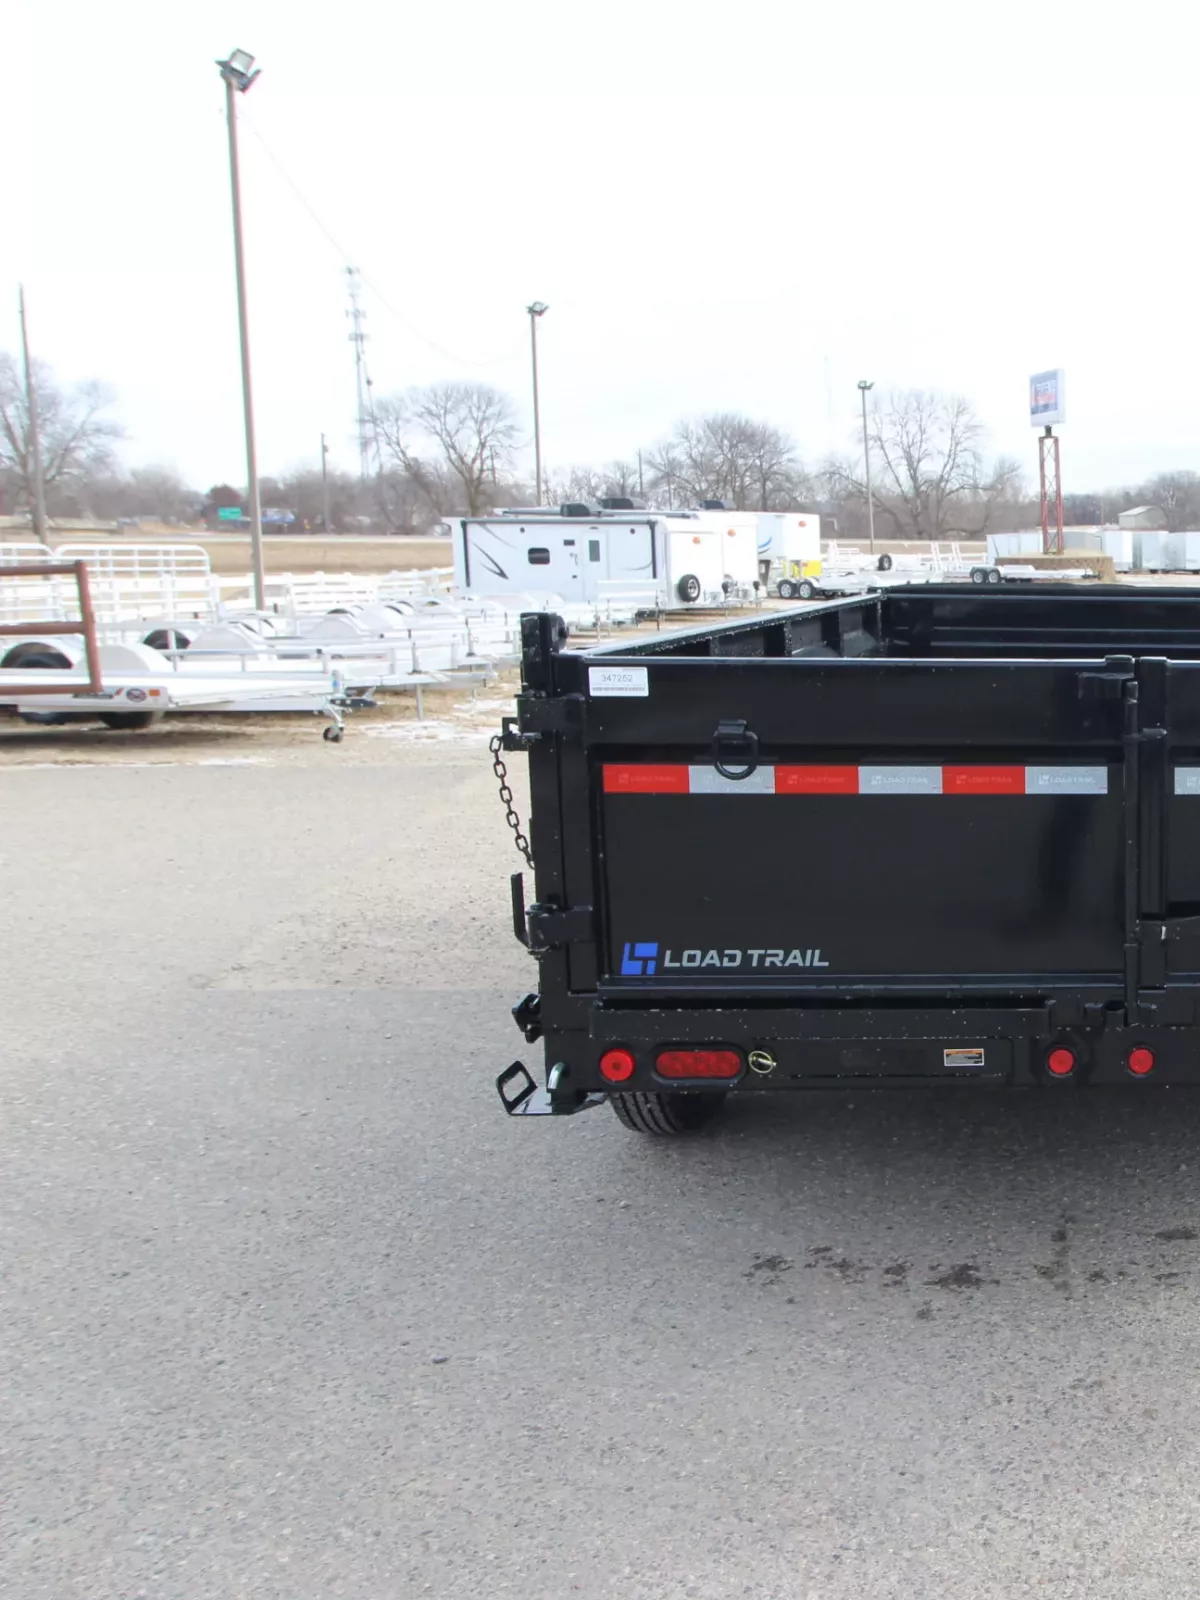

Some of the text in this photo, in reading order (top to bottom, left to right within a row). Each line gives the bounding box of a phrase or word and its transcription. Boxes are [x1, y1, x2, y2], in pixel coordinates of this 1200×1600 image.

[601, 674, 633, 682] 347252
[664, 949, 829, 967] LOAD TRAIL
